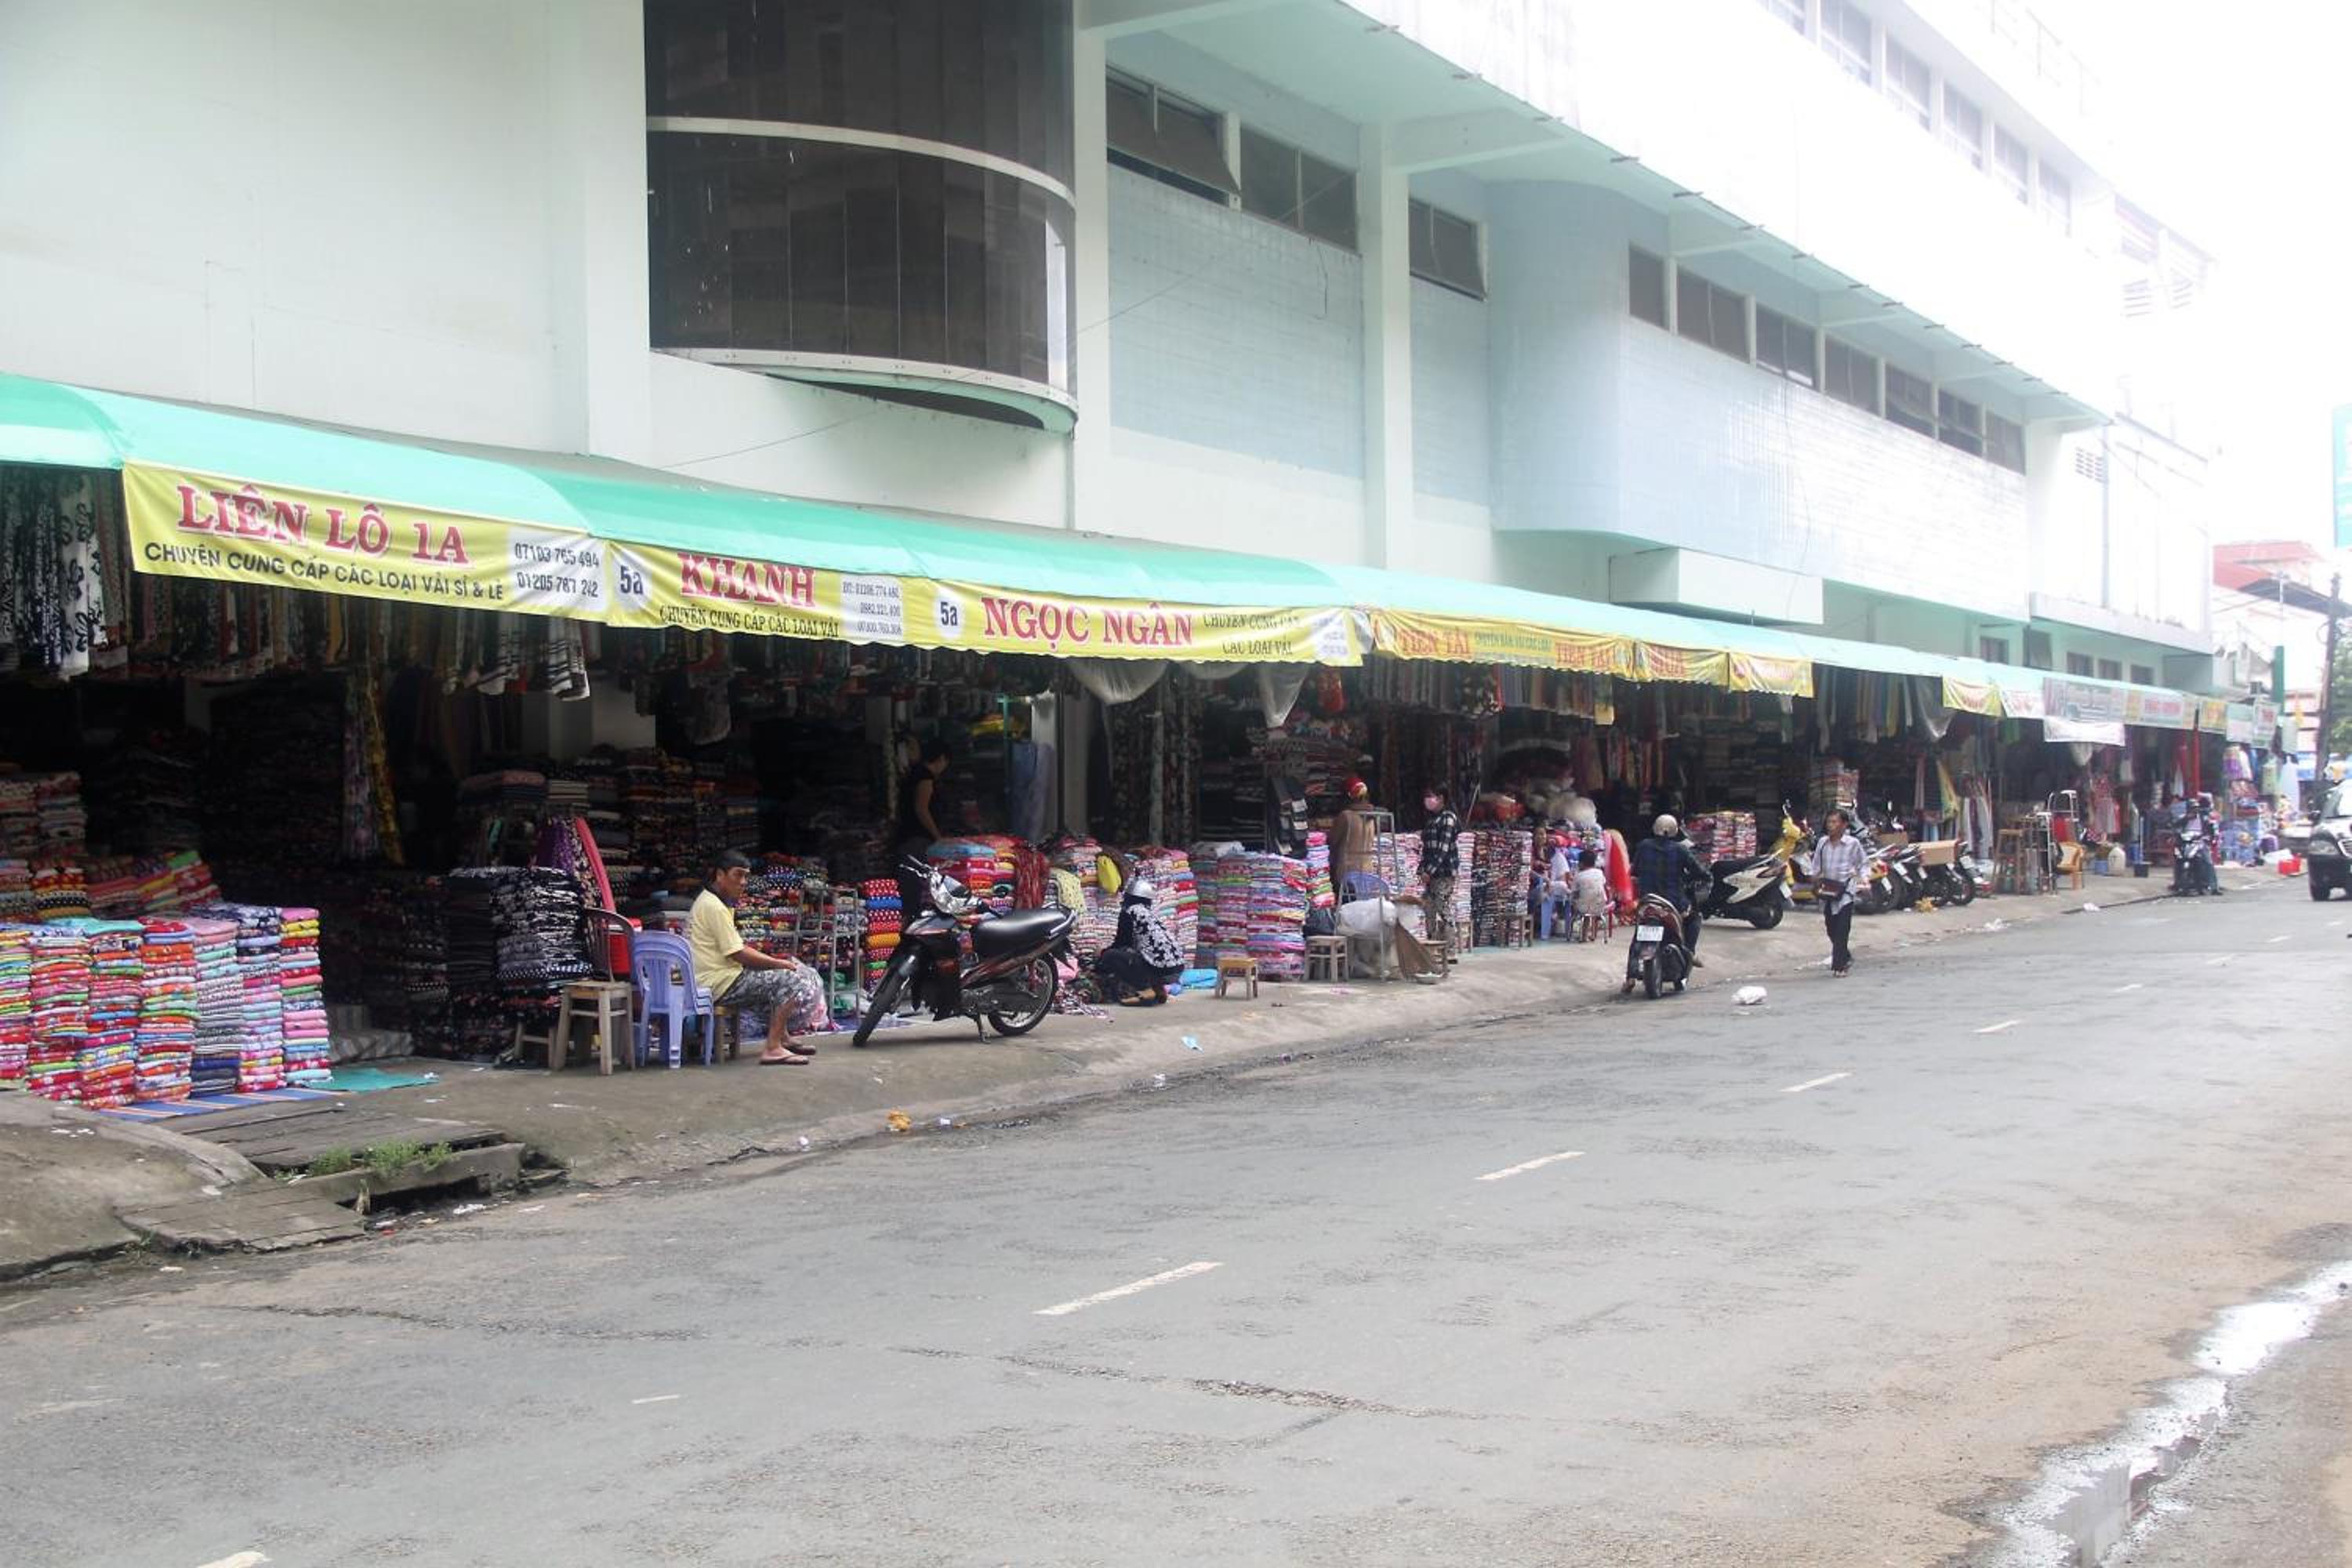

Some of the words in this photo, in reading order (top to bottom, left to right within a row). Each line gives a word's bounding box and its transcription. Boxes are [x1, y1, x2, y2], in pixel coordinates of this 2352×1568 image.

[177, 484, 308, 540] LIÊN
[326, 503, 390, 554] LÔ
[413, 522, 470, 564] 1A
[144, 542, 220, 568] CHUYÊN
[227, 552, 285, 574] CUNG
[292, 555, 329, 579] CẤP
[335, 562, 373, 585] CÁC
[379, 572, 416, 594] LOẠI
[473, 581, 484, 597] &
[517, 572, 553, 591] 01205
[620, 564, 644, 596] 5a
[710, 610, 740, 629] CUNG
[940, 601, 958, 626] 5a
[982, 597, 1090, 649] NGỌC
[1103, 602, 1192, 645] NGÂN
